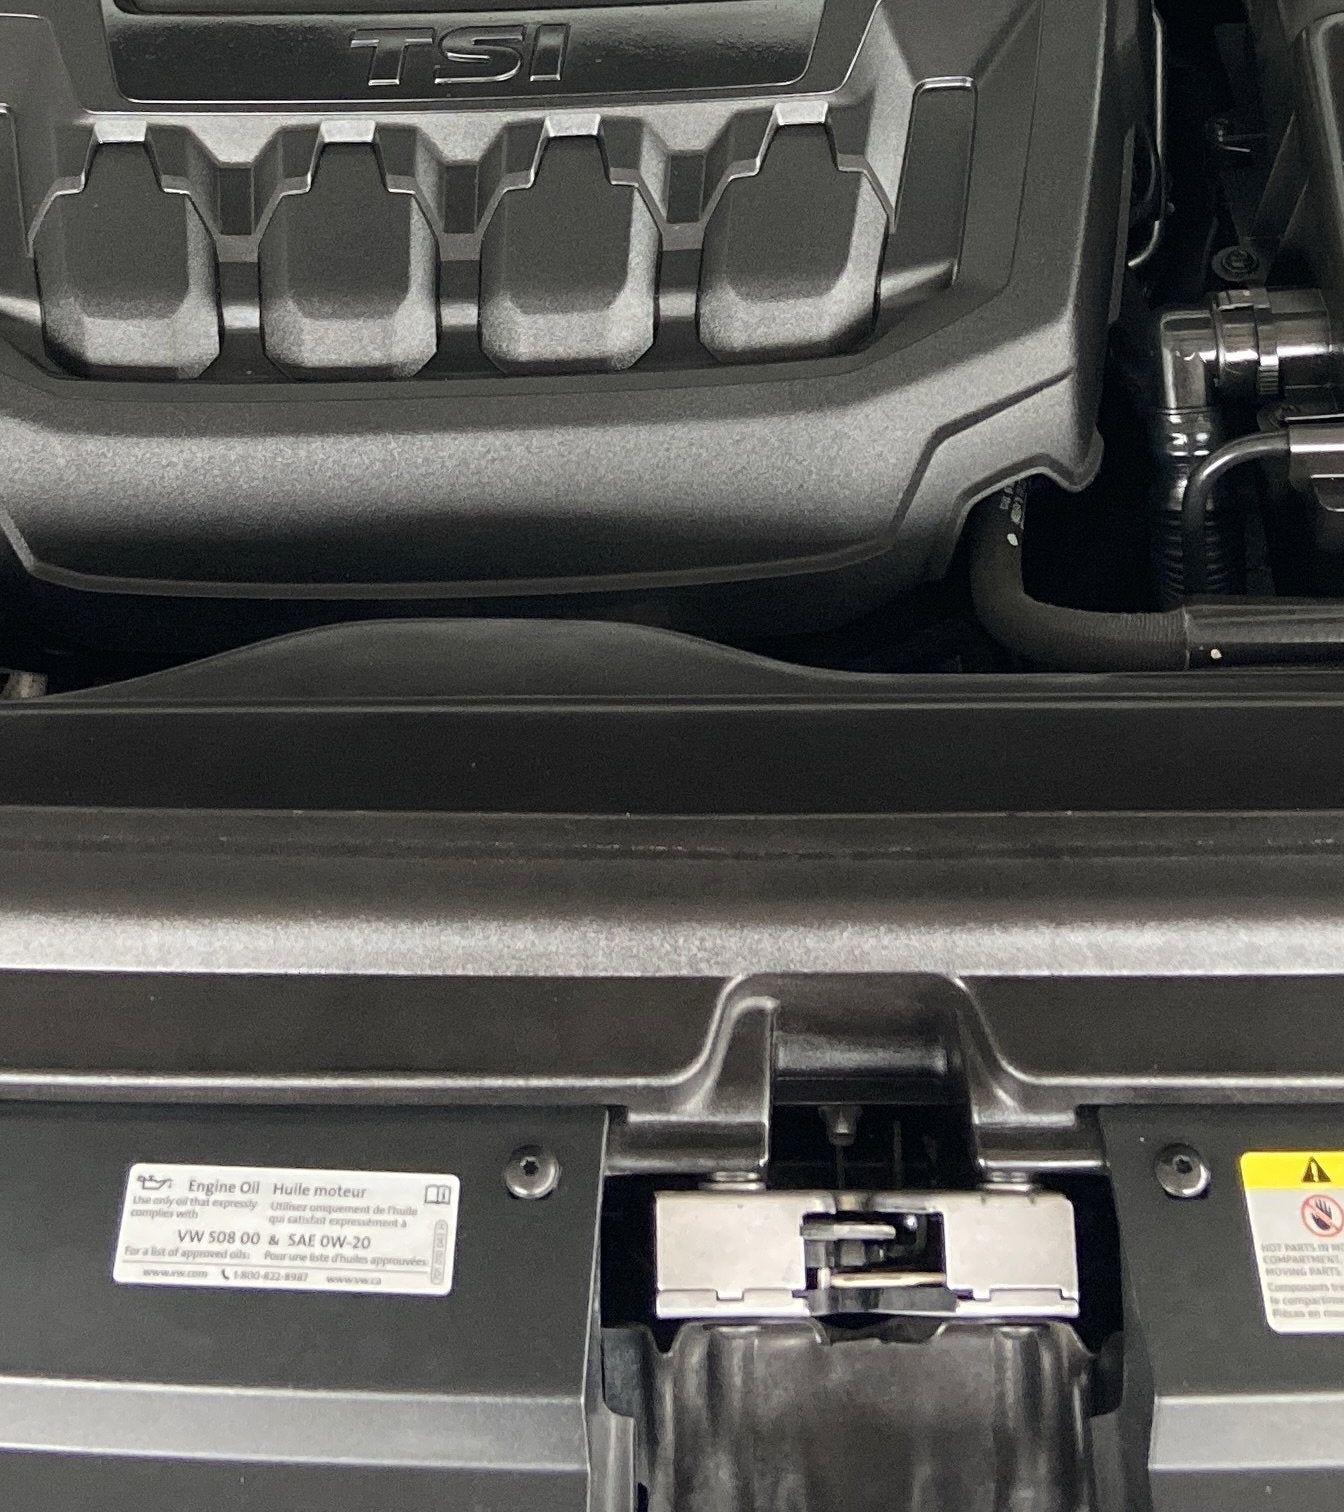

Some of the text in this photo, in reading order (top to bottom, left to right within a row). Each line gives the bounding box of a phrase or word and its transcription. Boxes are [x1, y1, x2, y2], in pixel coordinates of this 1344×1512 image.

[350, 22, 570, 87] TSI
[188, 1178, 261, 1196] Engine Oil
[273, 1182, 367, 1199] Huile moteur
[177, 1229, 372, 1249] VW 508 00 & SAE 0W-20
